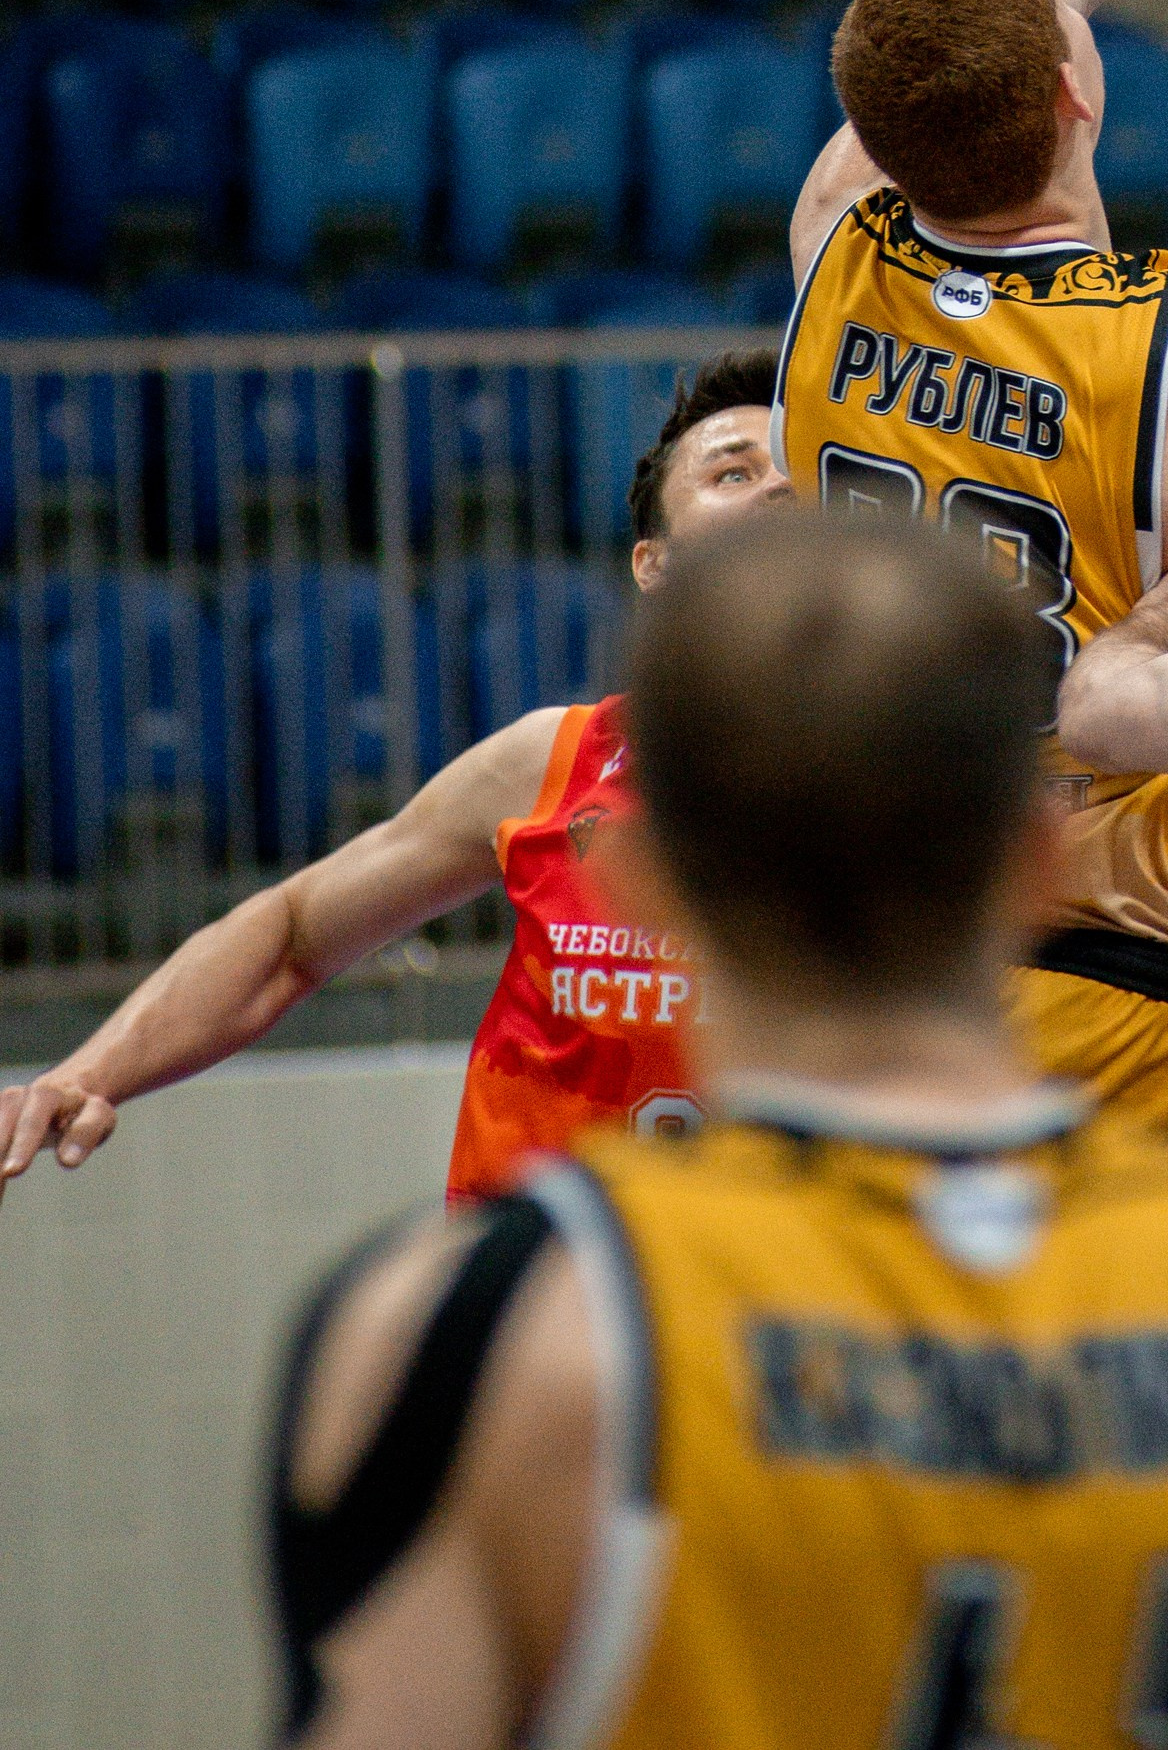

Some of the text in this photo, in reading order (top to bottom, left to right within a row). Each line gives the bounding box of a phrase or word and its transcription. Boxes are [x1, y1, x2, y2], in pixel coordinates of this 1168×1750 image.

[941, 286, 983, 307] РФБ
[828, 320, 1068, 460] РУБЛЕВ
[552, 966, 714, 1025] ЯСТР
